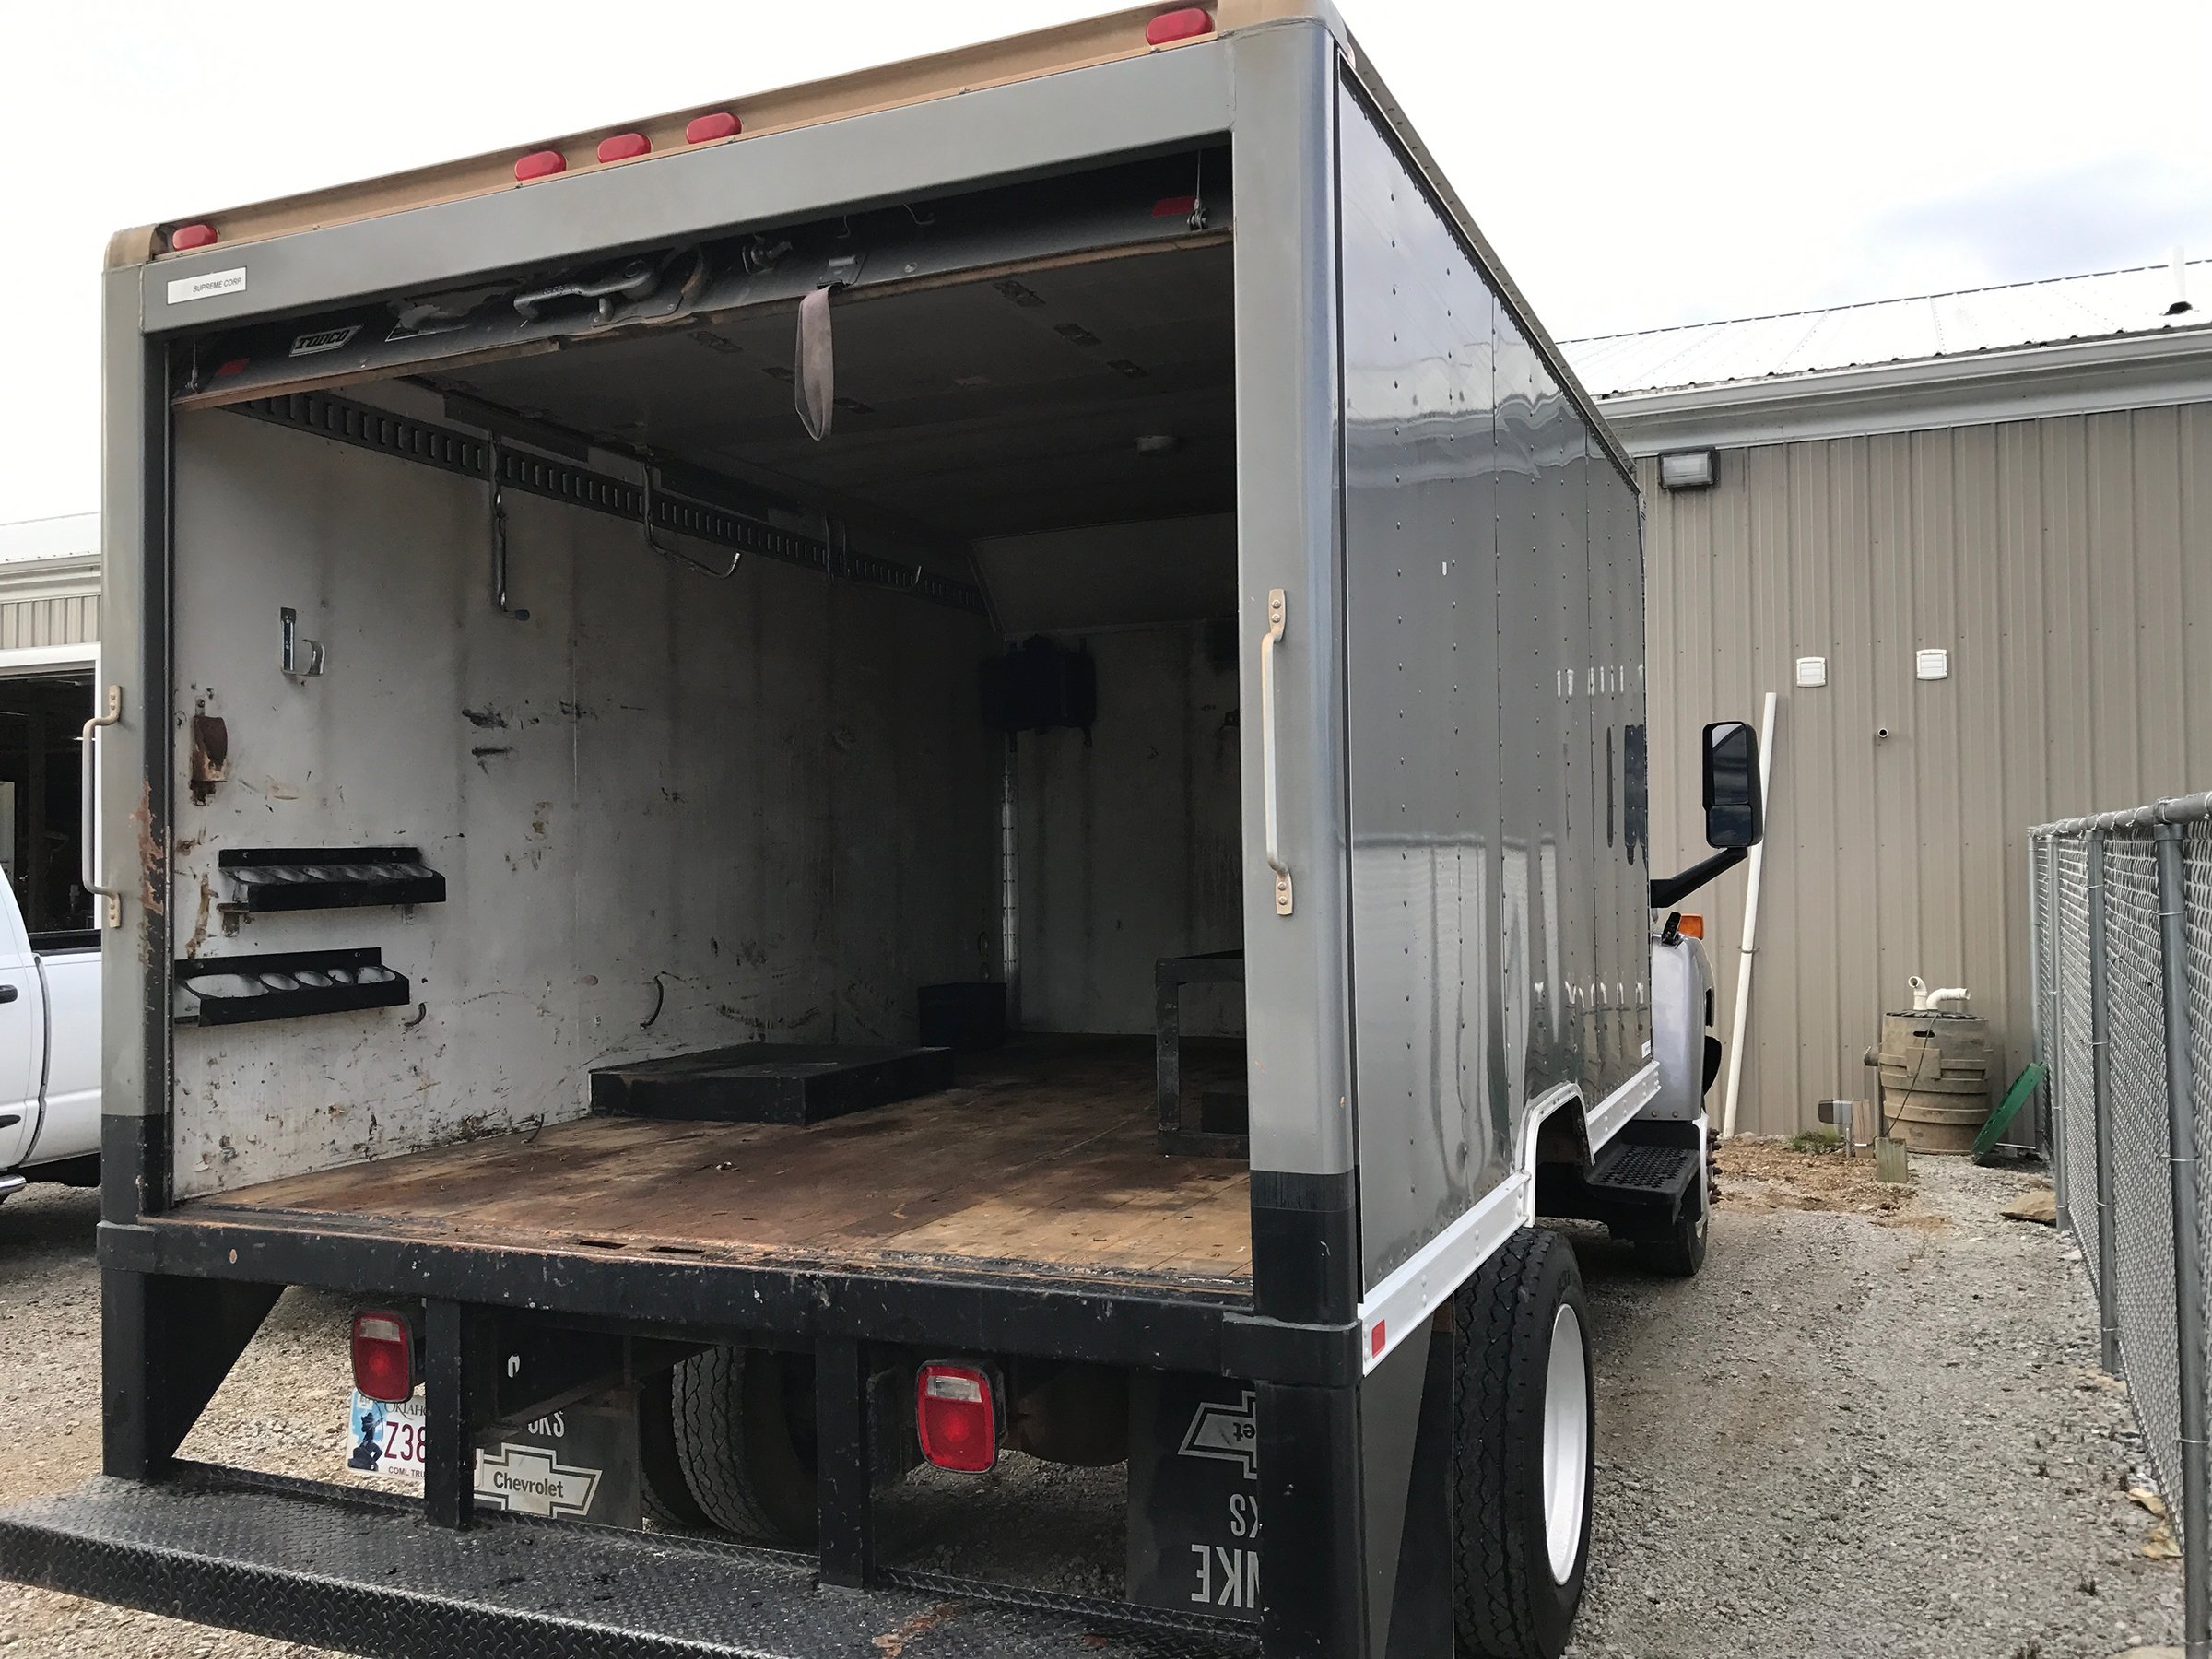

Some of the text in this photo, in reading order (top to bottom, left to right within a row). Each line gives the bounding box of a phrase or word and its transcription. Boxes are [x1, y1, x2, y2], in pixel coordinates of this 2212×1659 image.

[193, 280, 223, 293] SUPREME
[388, 1465, 408, 1476] COML
[493, 1471, 564, 1498] Chevrolet
